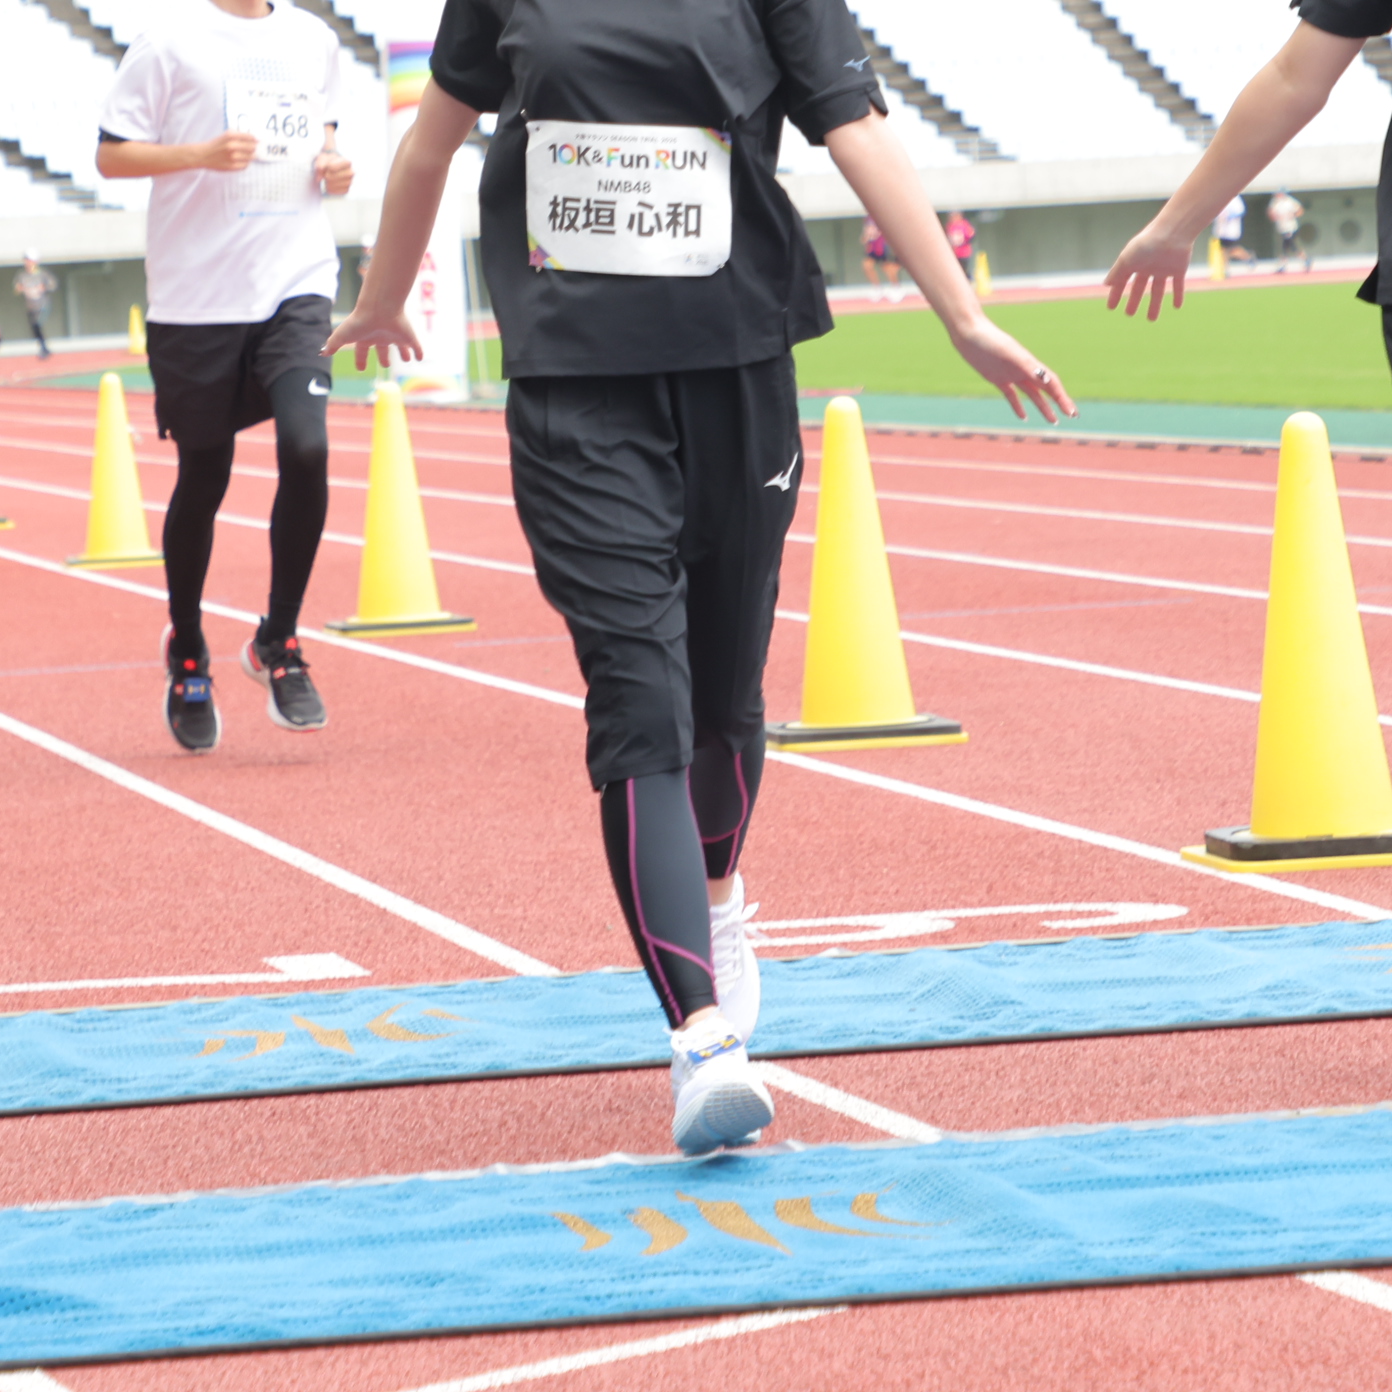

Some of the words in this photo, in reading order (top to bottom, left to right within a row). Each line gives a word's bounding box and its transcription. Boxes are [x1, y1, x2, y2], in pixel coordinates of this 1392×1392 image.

[265, 113, 309, 138] 468
[266, 144, 289, 157] 10K
[655, 149, 708, 171] RUN
[597, 179, 651, 194] NMB48
